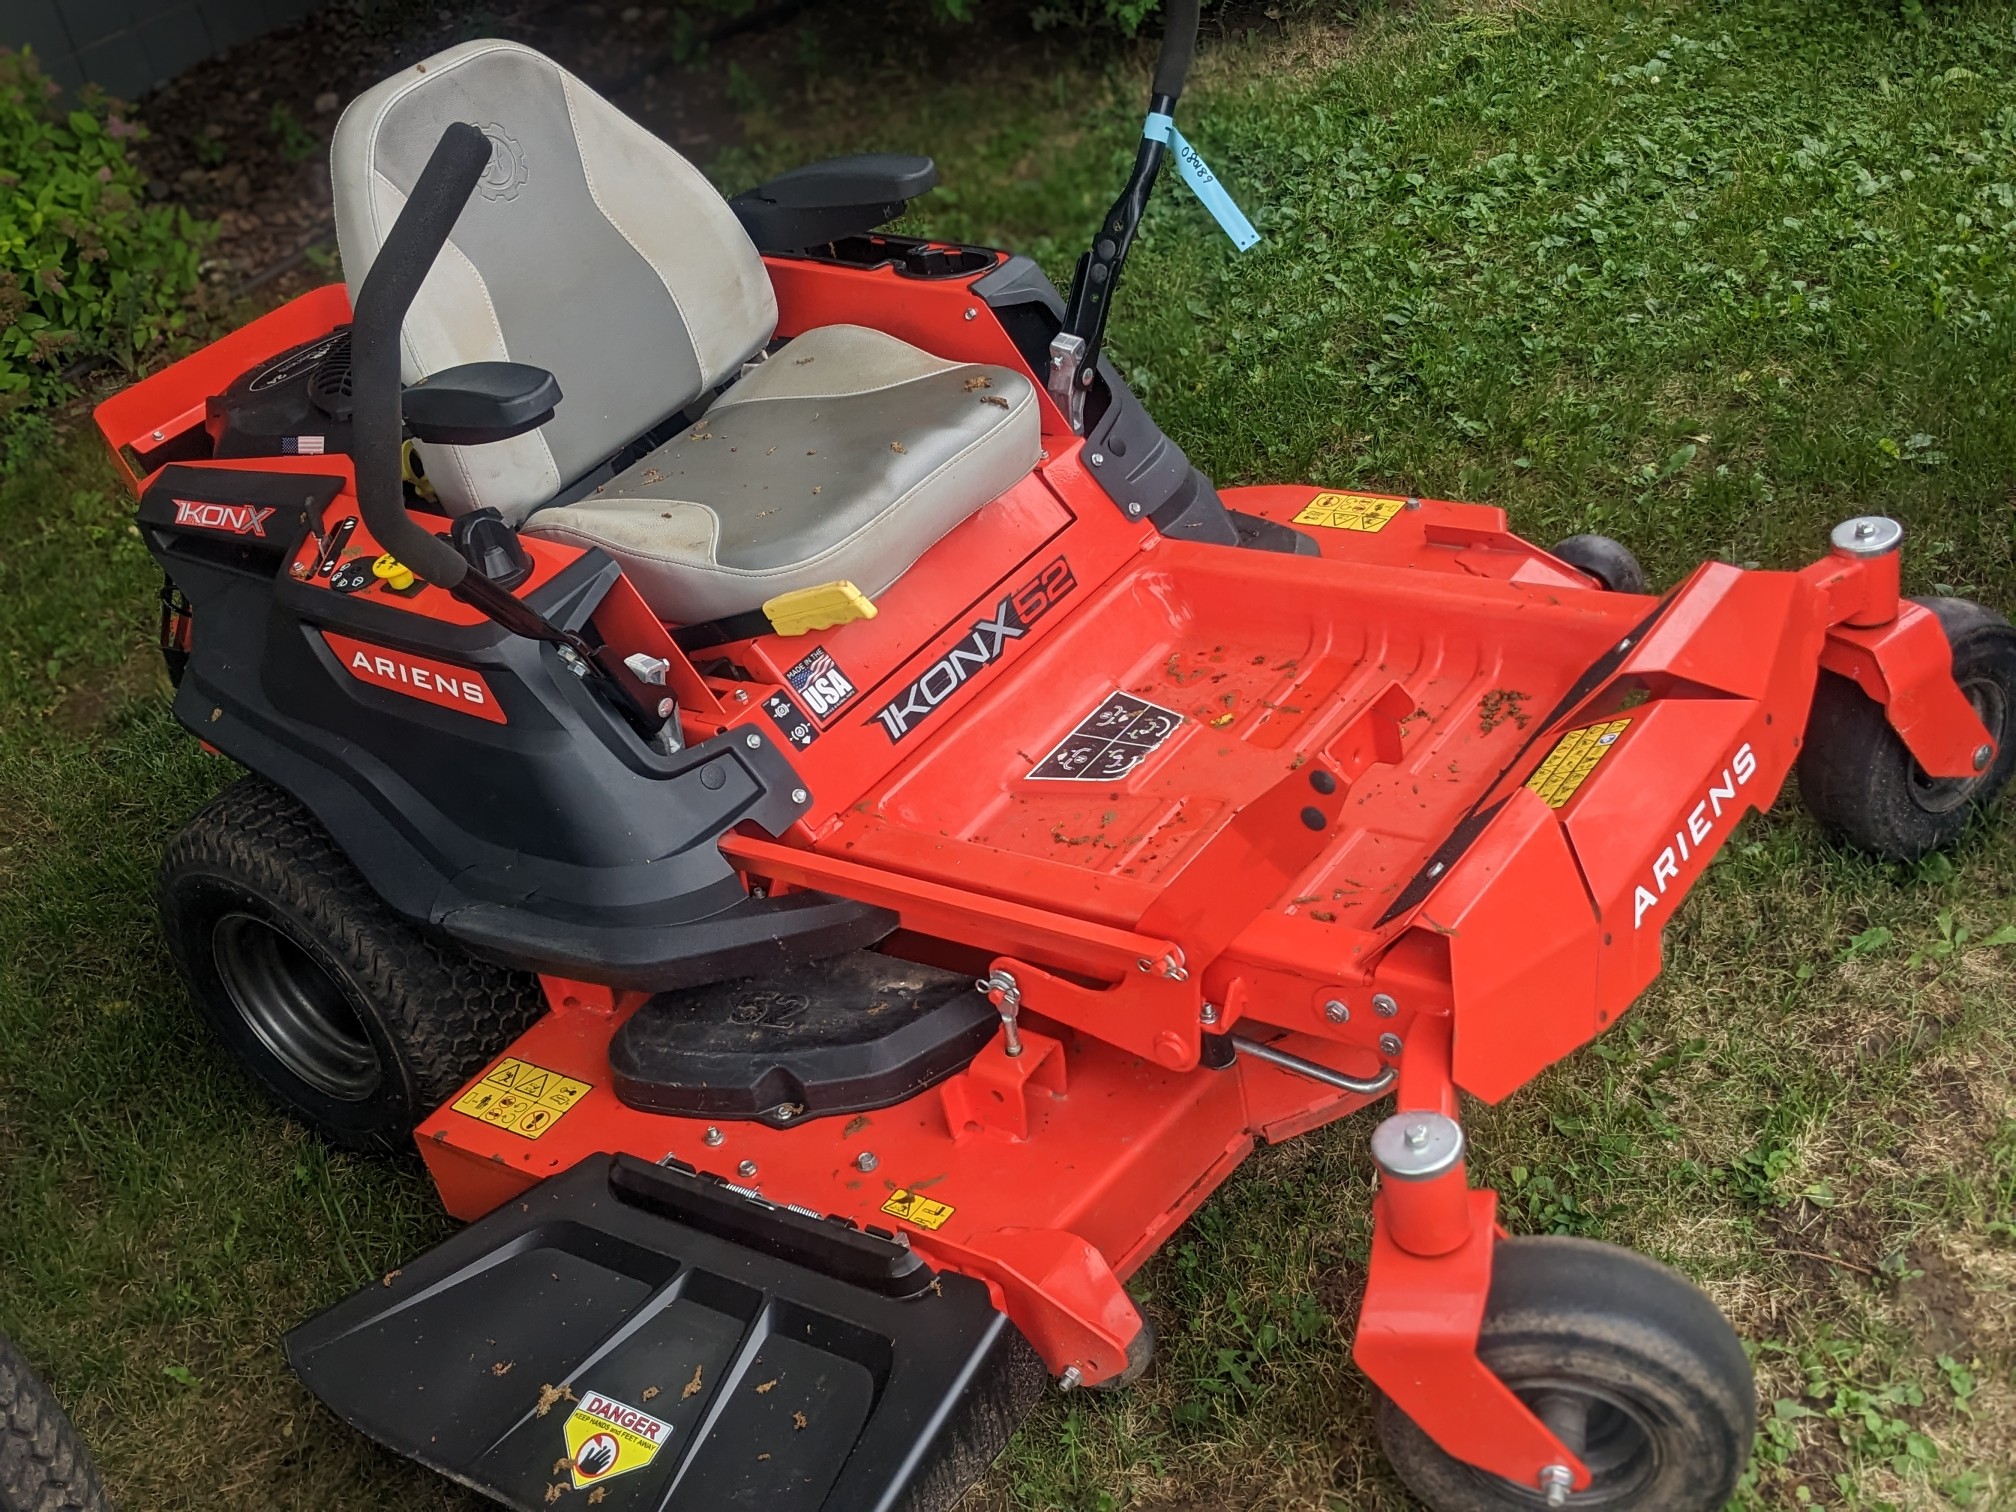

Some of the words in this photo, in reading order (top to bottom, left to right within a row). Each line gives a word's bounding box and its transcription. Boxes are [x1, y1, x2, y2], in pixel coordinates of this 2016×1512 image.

[352, 650, 485, 705] ARIENS
[786, 662, 806, 680] MADE
[803, 657, 812, 666] IN
[810, 648, 824, 660] THE
[802, 668, 853, 714] USA
[1633, 742, 1757, 930] ARIENS
[574, 1412, 590, 1422] KEEP
[590, 1418, 610, 1431] HANDS
[609, 1427, 622, 1436] and
[621, 1431, 638, 1444] FEET
[637, 1439, 656, 1452] AWAY
[586, 1397, 662, 1440] DANGER
